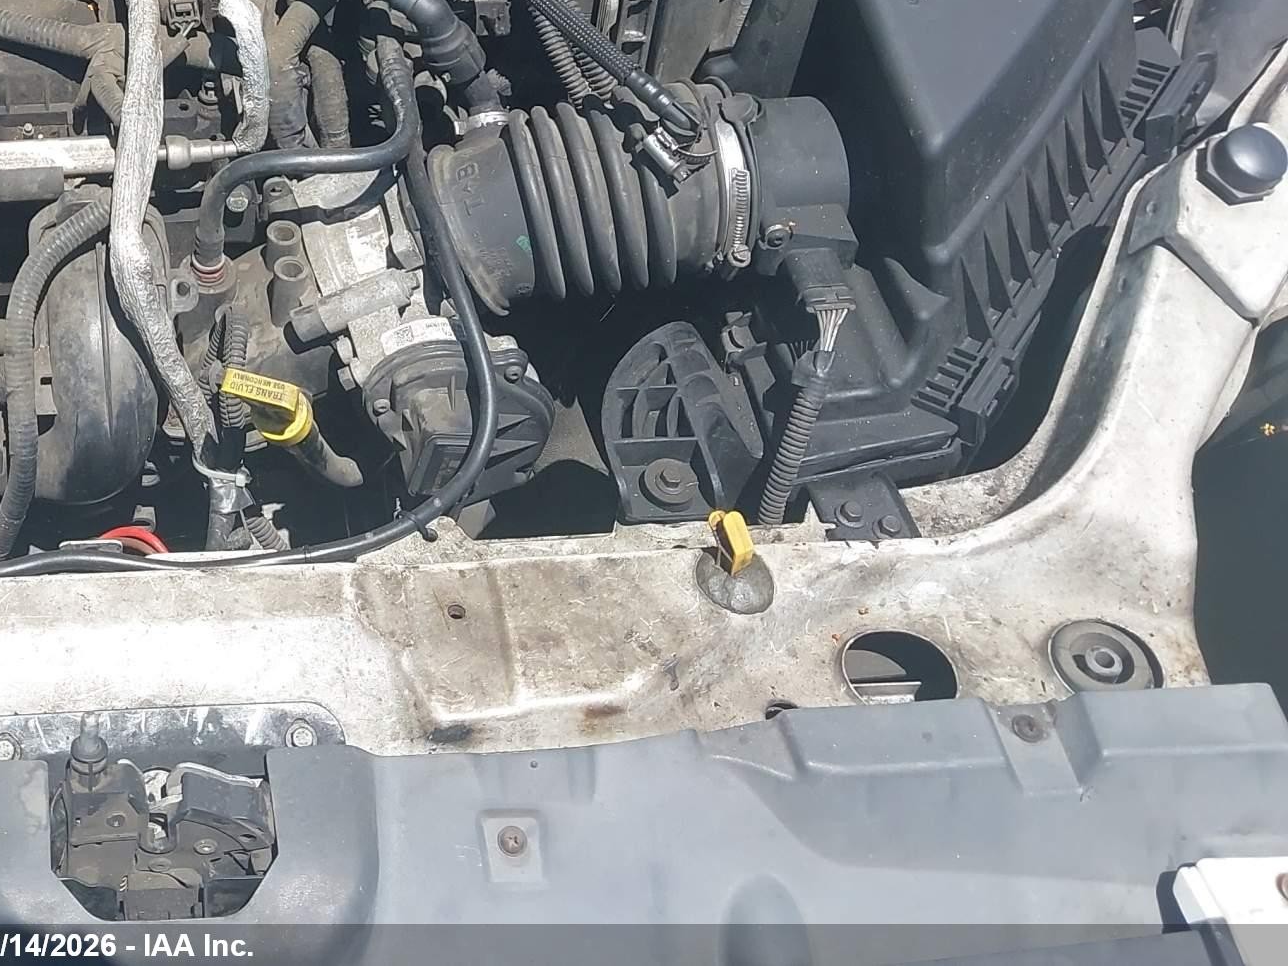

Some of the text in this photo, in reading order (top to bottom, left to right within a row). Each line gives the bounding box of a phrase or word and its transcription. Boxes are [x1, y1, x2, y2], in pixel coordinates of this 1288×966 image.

[229, 381, 283, 400] TRANS FLUID
[273, 380, 286, 390] USE
